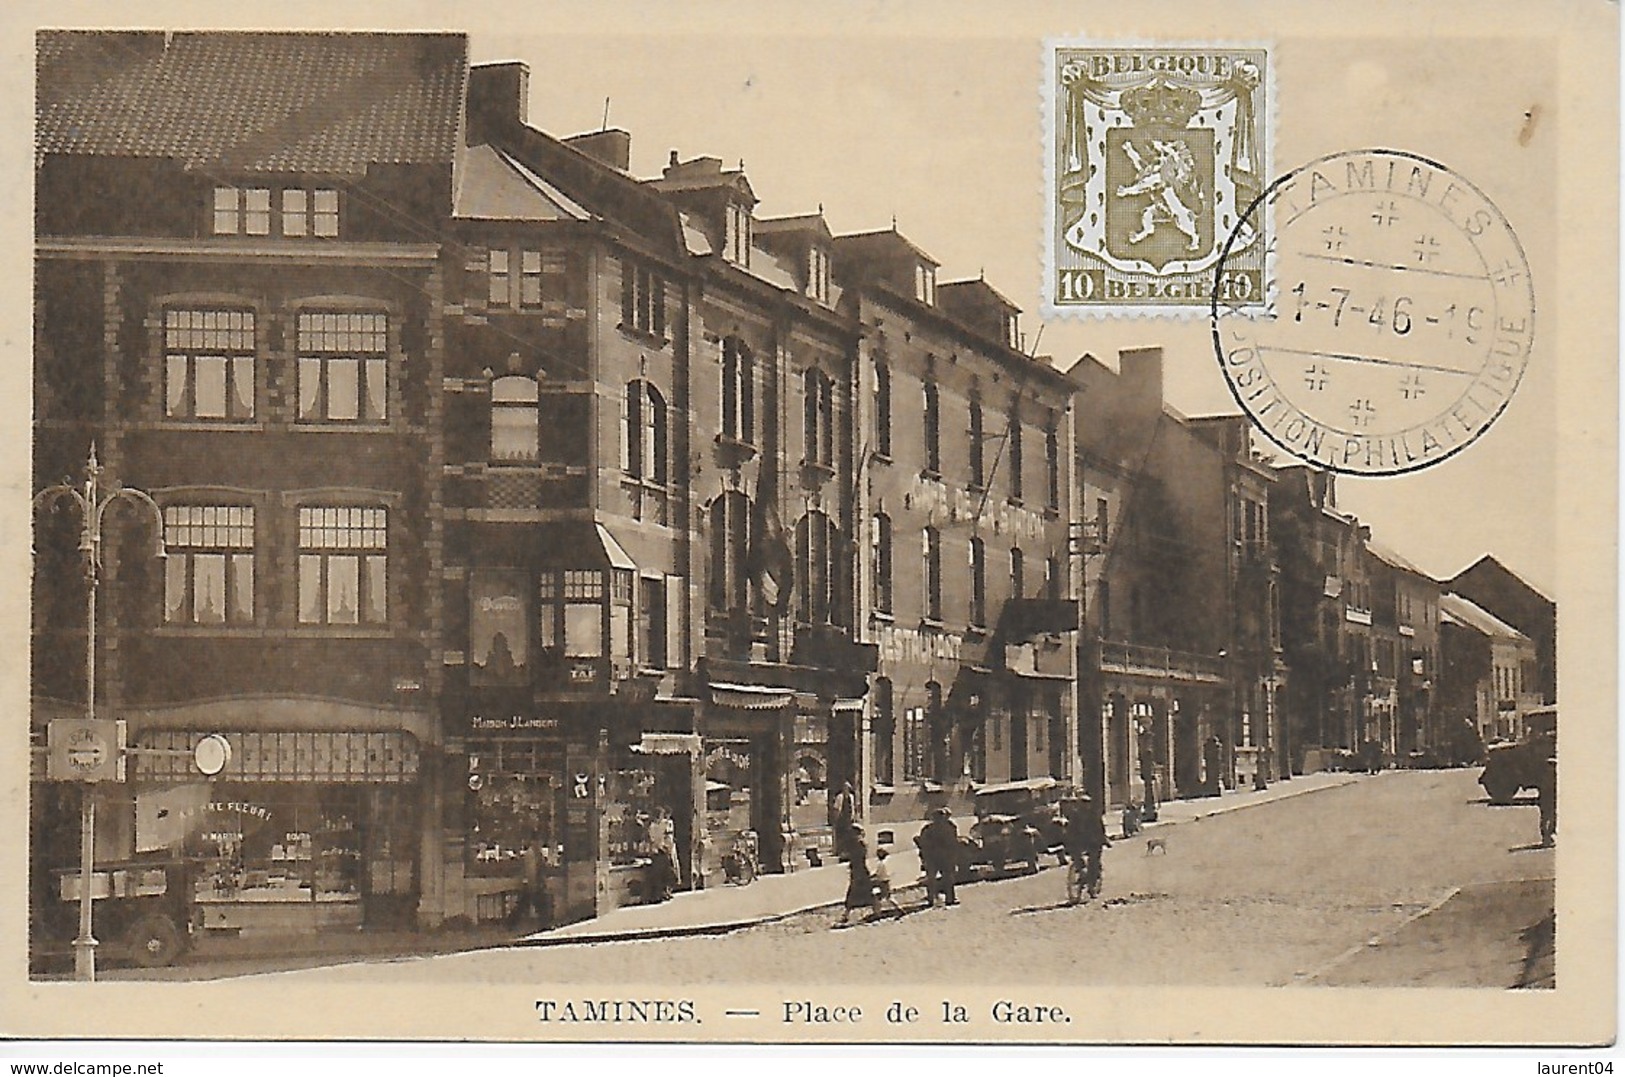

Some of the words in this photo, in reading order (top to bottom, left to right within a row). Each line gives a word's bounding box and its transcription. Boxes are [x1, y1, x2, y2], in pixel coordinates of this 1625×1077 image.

[1092, 54, 1231, 78] BELGIQUE
[1060, 271, 1094, 299] 10
[1219, 271, 1252, 299] 10
[1343, 315, 1526, 467] PHILATELIQUE
[536, 1000, 702, 1024] TAMINES.
[782, 1000, 862, 1024] Place
[886, 1000, 919, 1024] de
[941, 1000, 969, 1024] la
[992, 1000, 1072, 1024] Gare.
